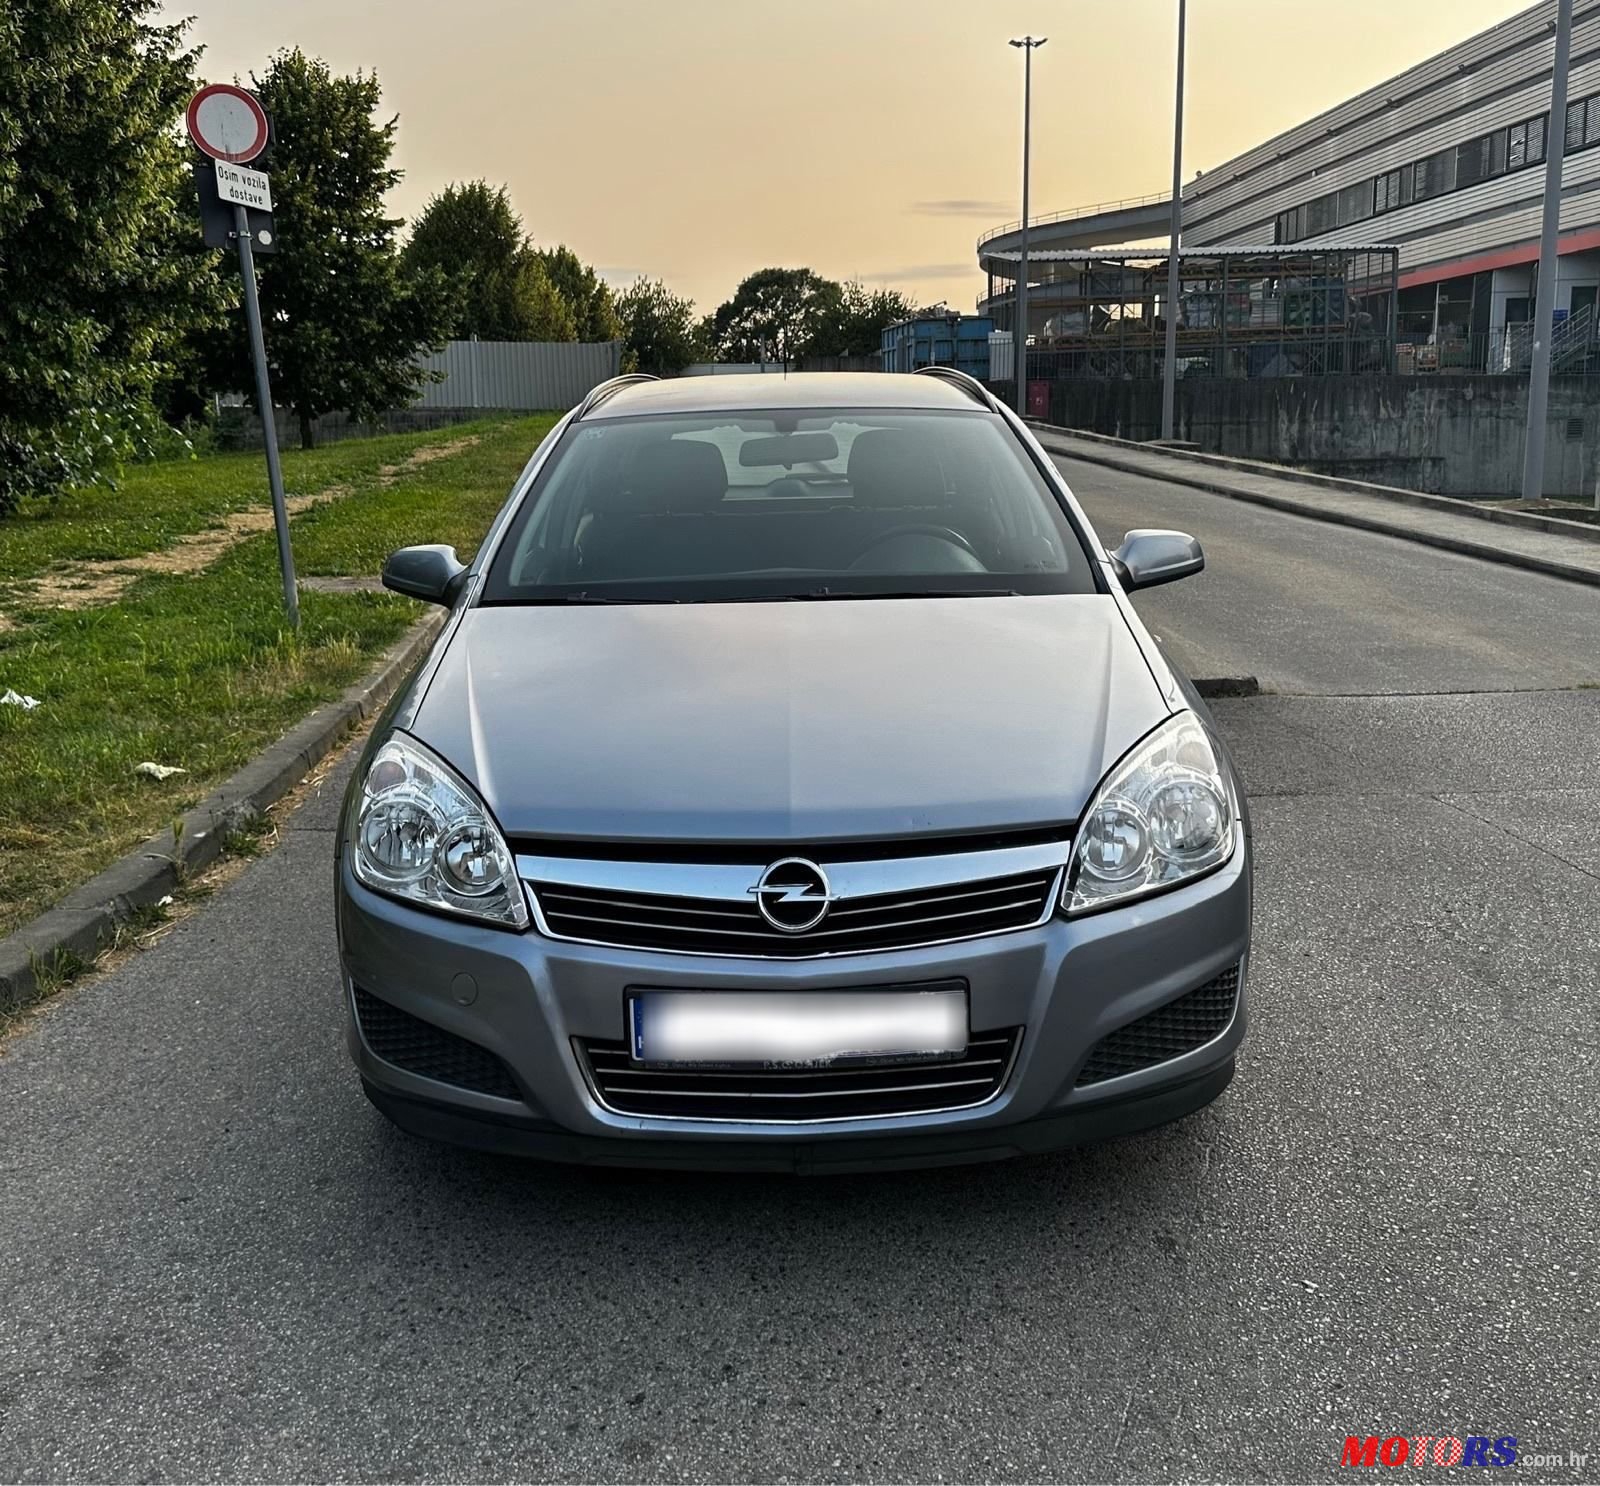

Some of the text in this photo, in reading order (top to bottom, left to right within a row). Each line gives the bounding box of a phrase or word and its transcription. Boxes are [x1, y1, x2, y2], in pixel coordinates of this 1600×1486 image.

[218, 166, 267, 190] Osim vozila
[230, 186, 263, 205] dostave
